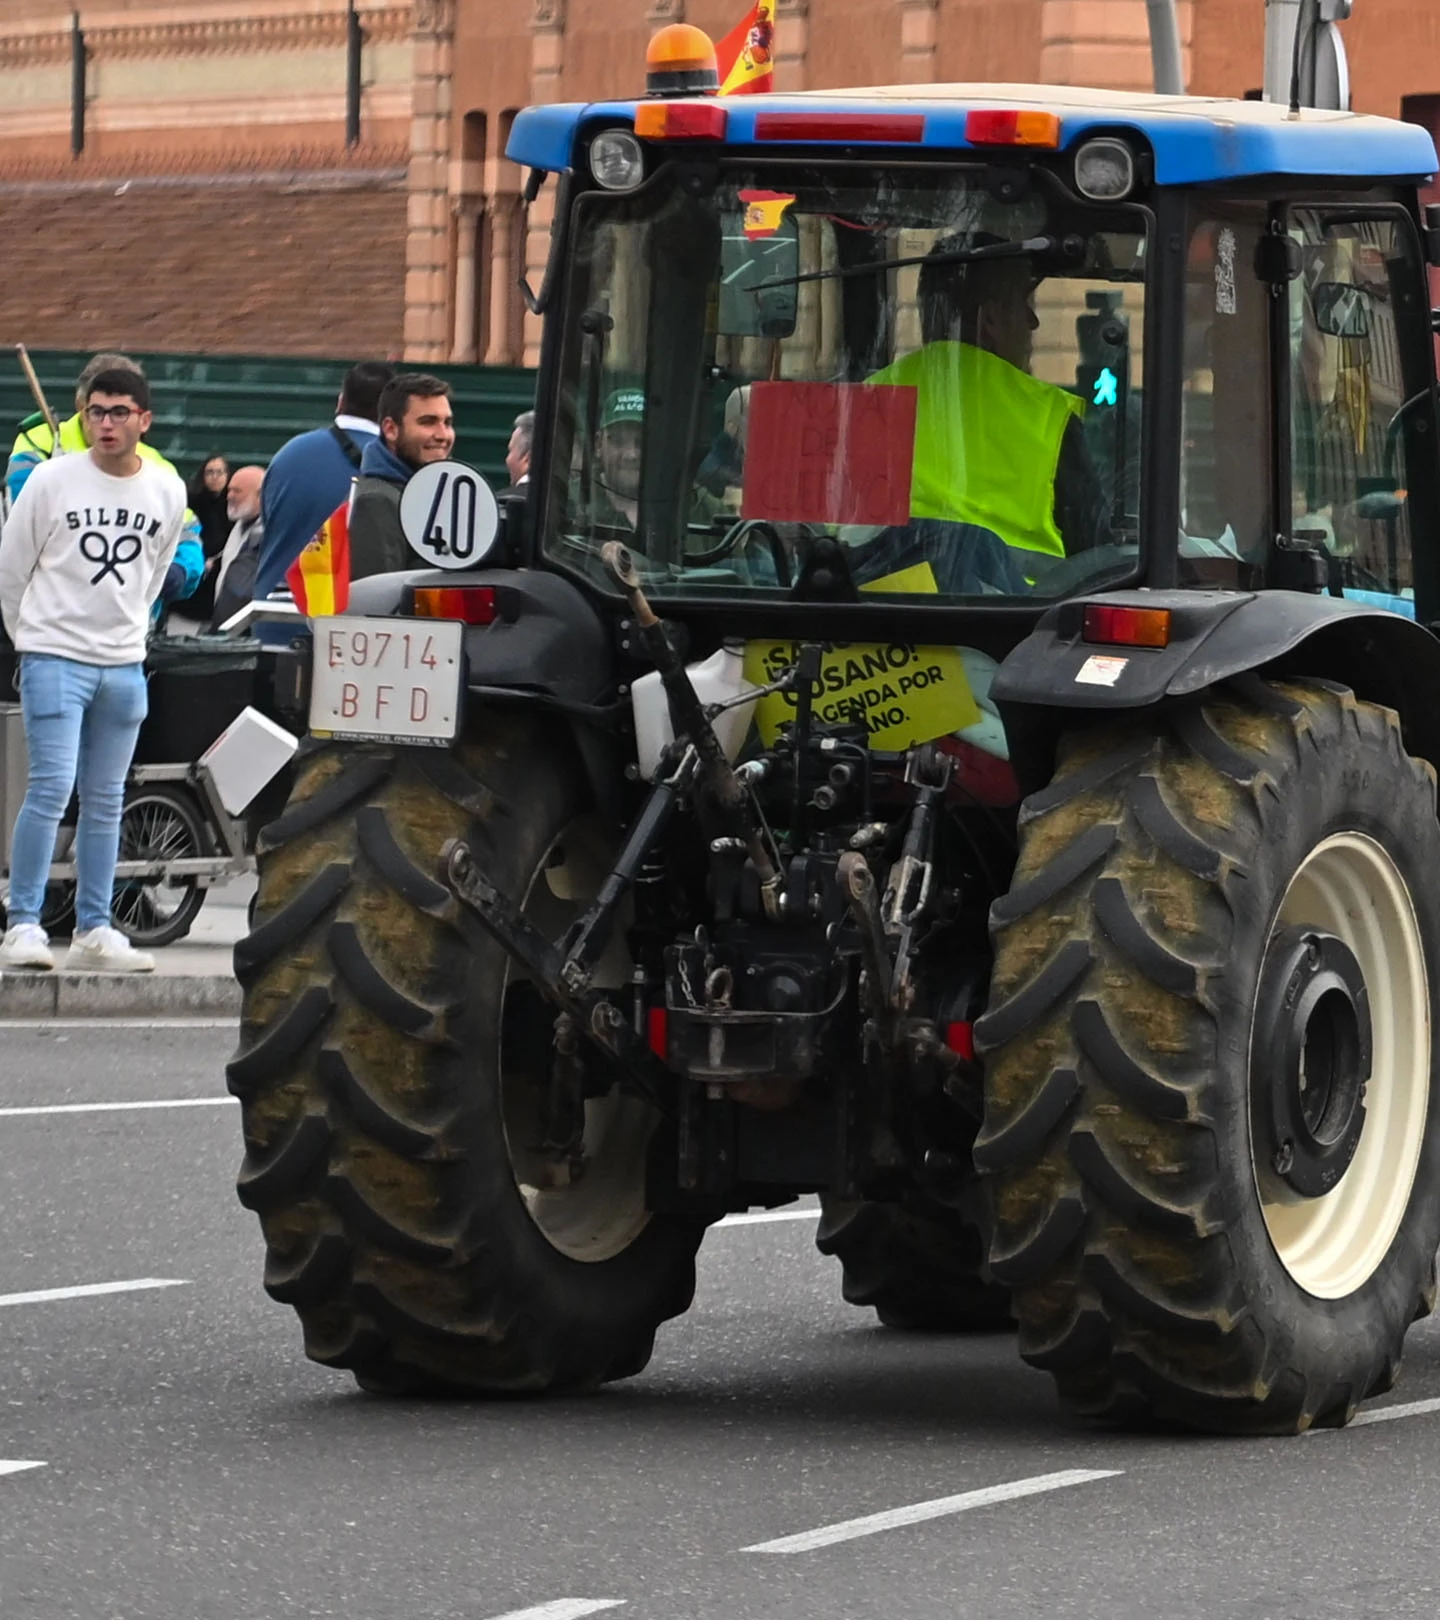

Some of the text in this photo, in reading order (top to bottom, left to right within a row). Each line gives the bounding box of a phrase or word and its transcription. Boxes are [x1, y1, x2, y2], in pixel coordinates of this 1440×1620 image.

[66, 508, 162, 538] SILBON
[422, 472, 476, 559] 40
[898, 665, 944, 695] POR
